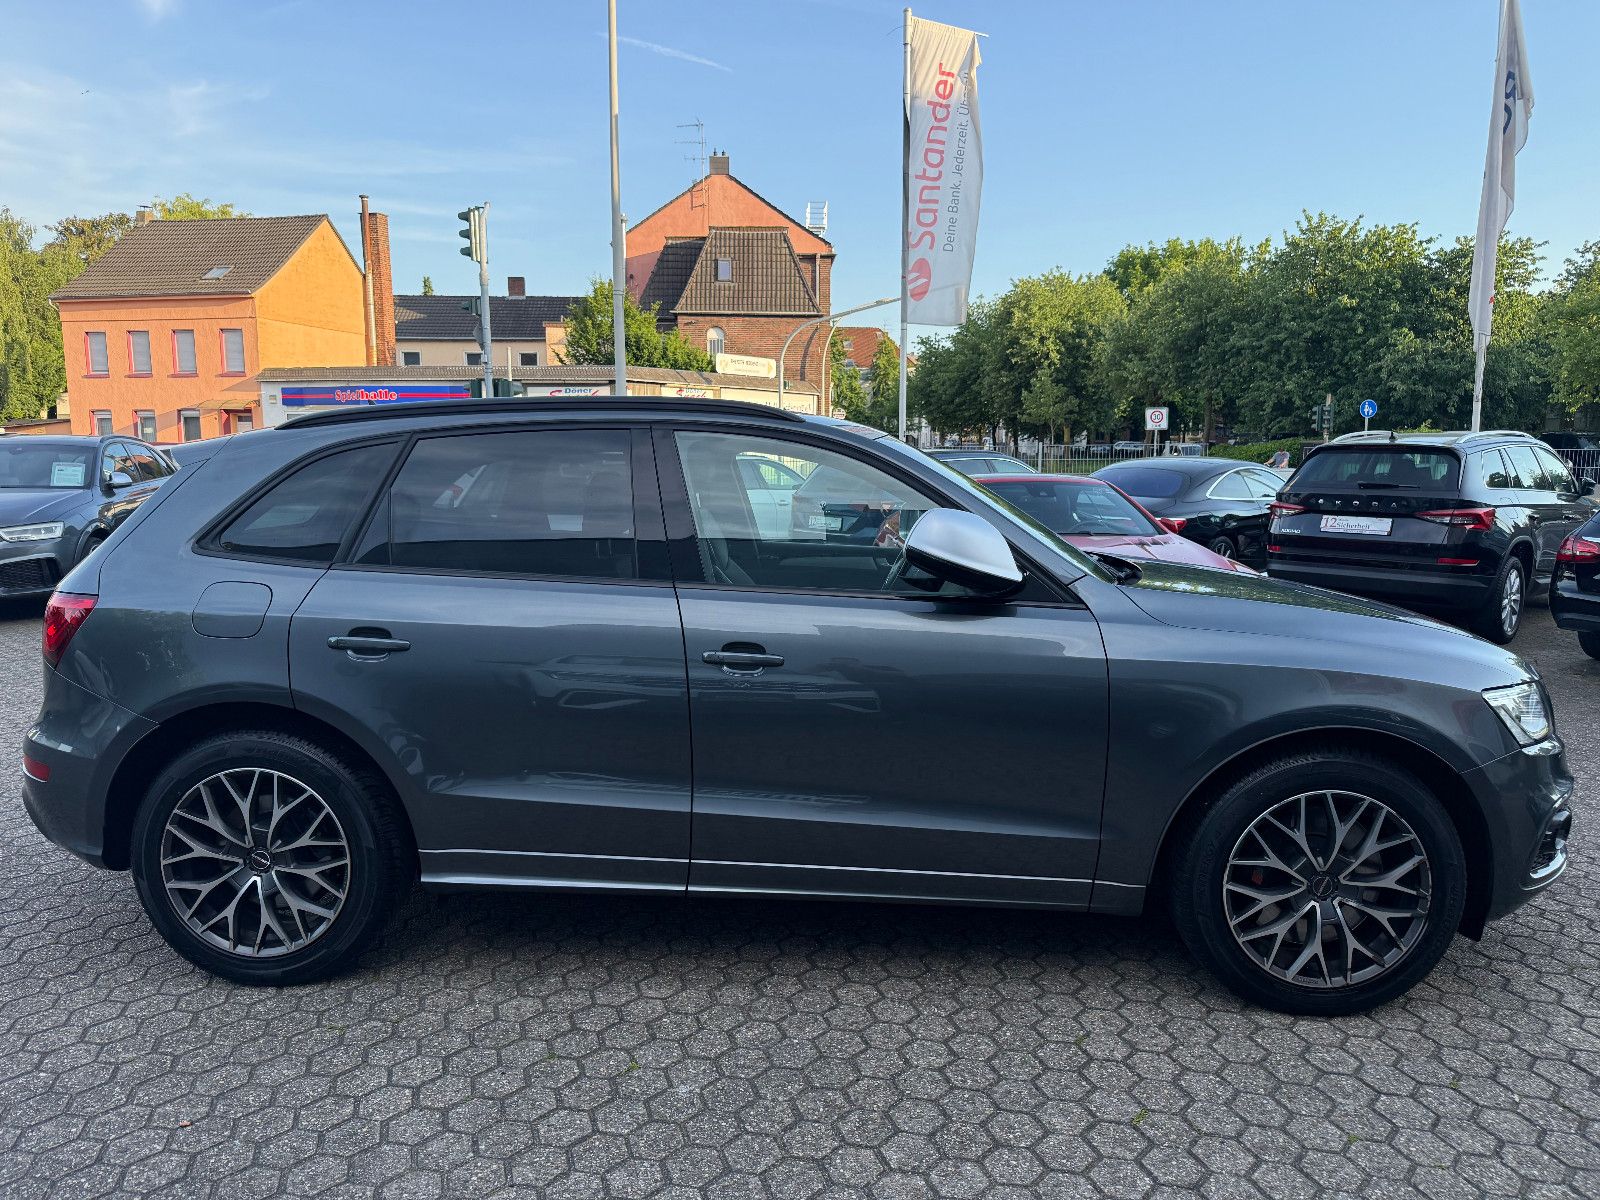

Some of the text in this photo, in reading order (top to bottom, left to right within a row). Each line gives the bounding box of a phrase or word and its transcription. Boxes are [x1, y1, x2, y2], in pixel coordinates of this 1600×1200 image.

[908, 62, 955, 250] Santander
[952, 119, 969, 177] Jederzeit.
[947, 180, 963, 213] Bank.
[943, 217, 957, 252] Deine
[335, 389, 398, 402] Spielhalle
[1322, 517, 1371, 530] 12 Sicherheit
